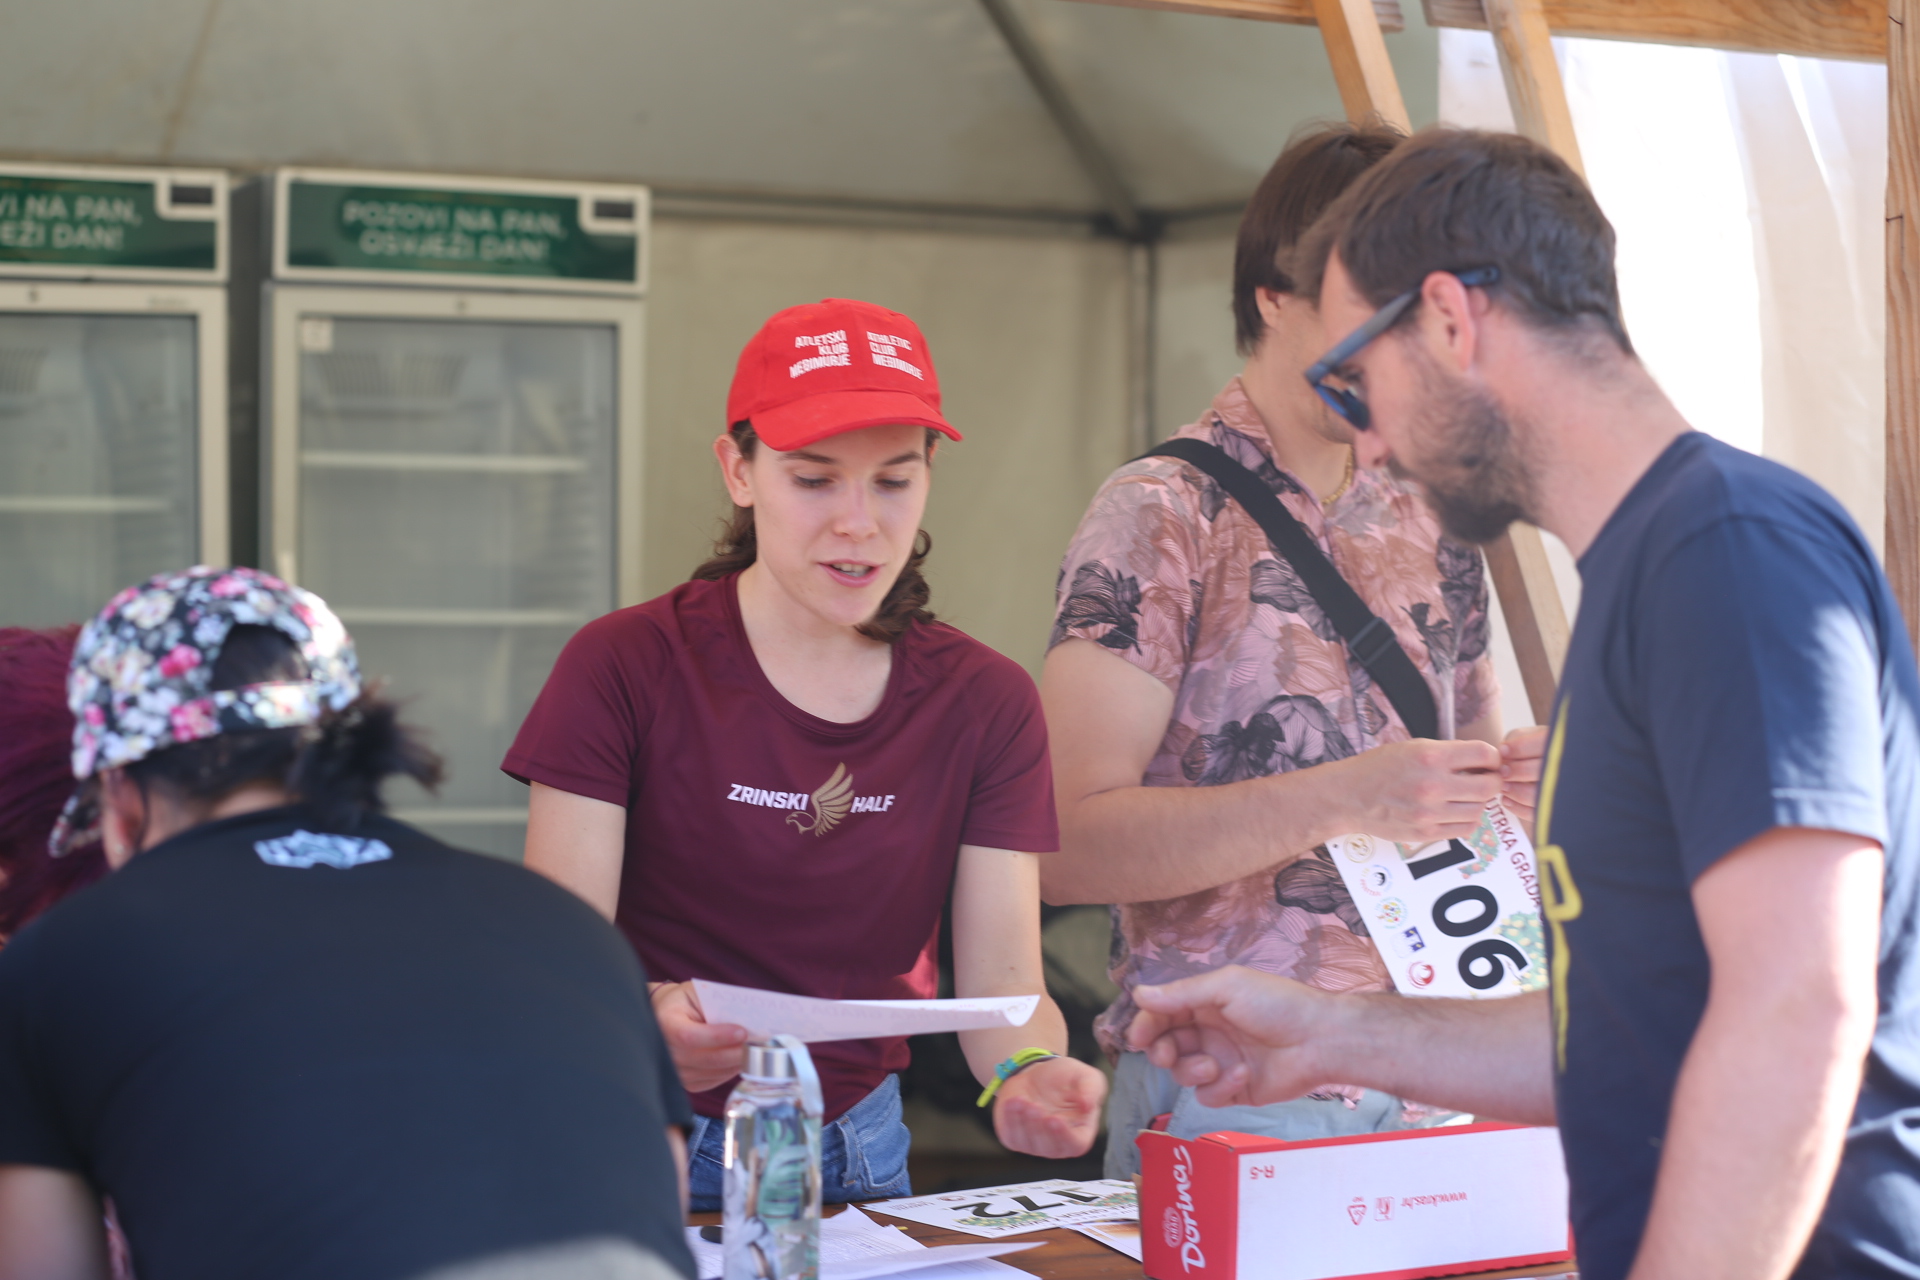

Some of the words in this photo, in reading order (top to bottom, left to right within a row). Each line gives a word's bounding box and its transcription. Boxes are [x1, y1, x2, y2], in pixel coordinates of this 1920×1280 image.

[24, 194, 67, 219] NA
[343, 200, 449, 229] POZOVI
[454, 207, 497, 232] NA
[795, 330, 848, 348] ATLETSKI
[818, 342, 850, 355] KLUB
[866, 331, 912, 351] ATHLETIC
[869, 341, 897, 356] CLUB
[727, 783, 809, 811] ZRINSKI
[850, 795, 895, 813] HALF
[1485, 797, 1518, 851] UTRKA
[1406, 837, 1529, 990] 106
[1249, 1165, 1275, 1180] R-5
[950, 1188, 1100, 1218] 172
